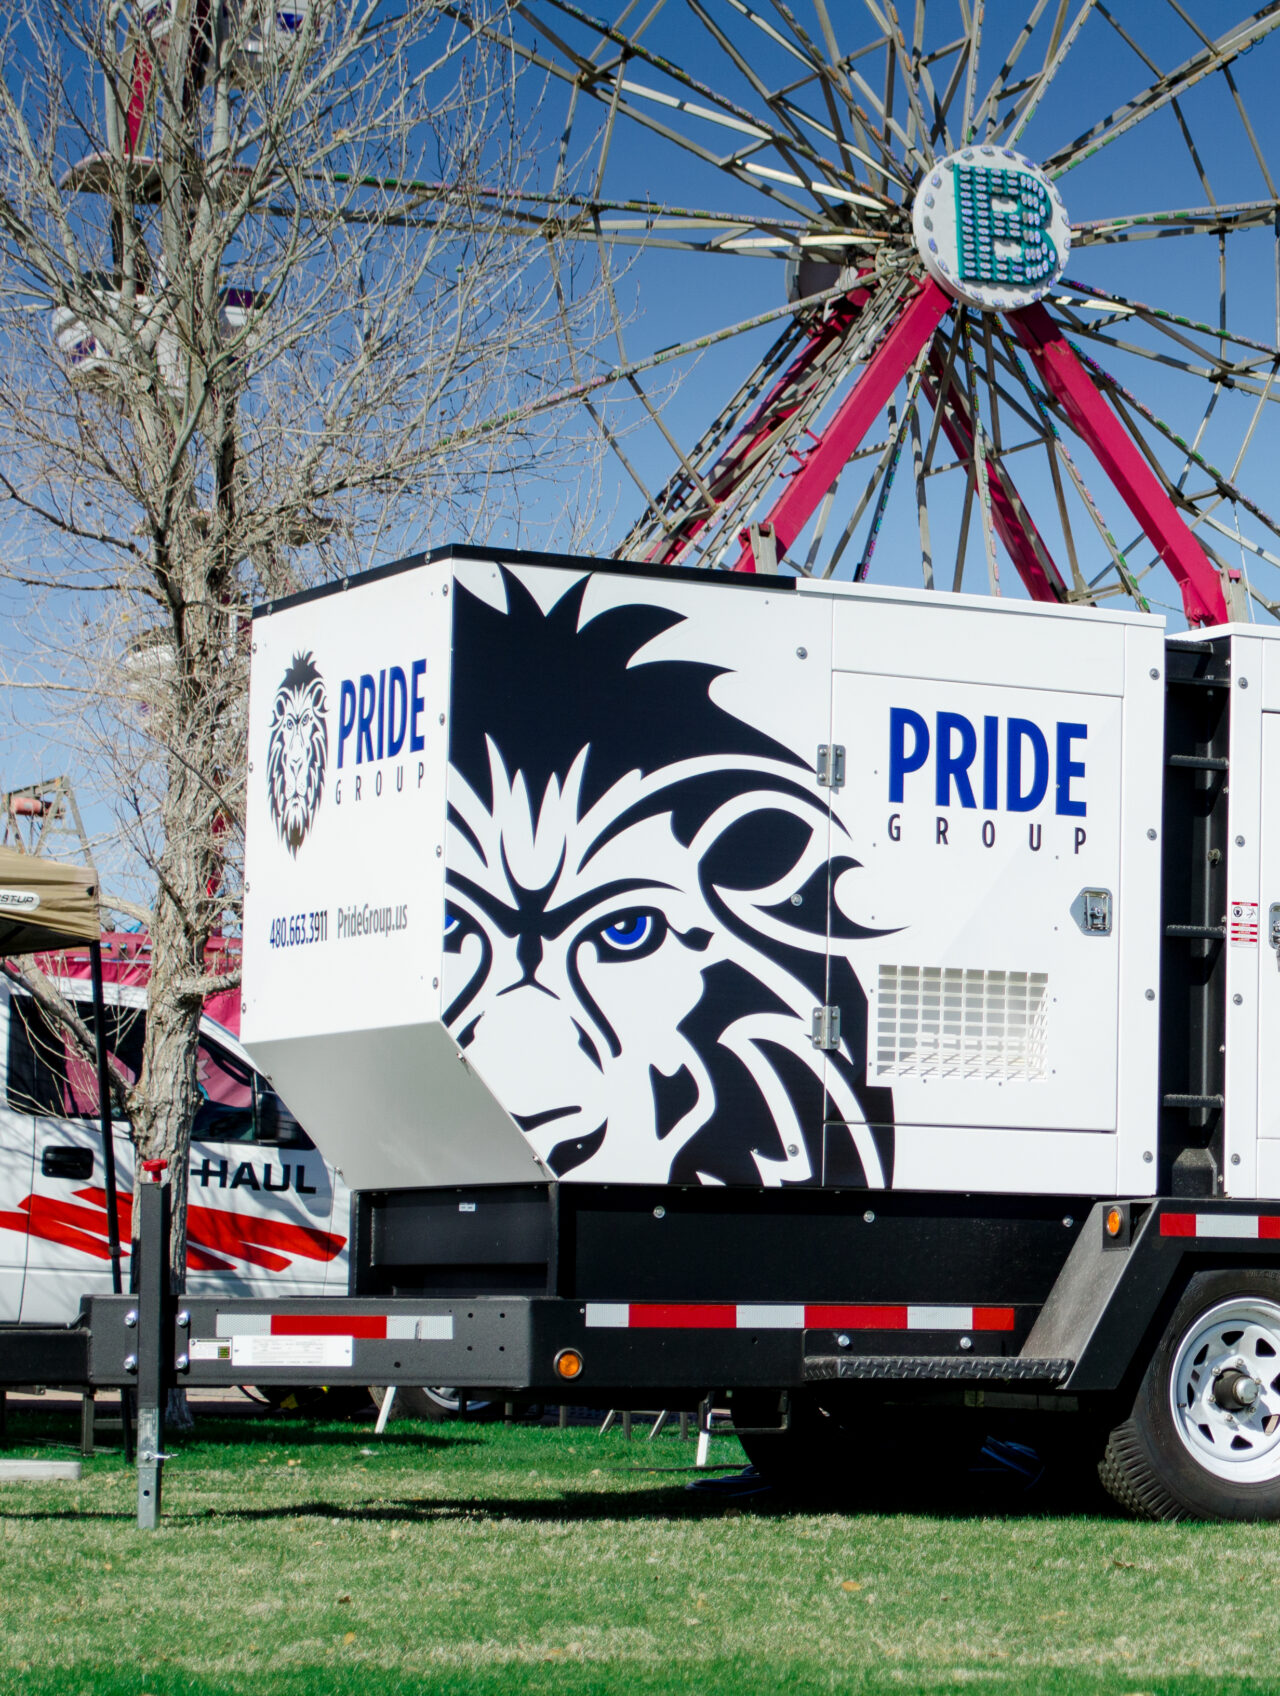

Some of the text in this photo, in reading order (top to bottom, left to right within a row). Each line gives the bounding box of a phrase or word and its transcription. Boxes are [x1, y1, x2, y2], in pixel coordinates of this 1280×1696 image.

[953, 164, 1058, 286] B
[337, 658, 427, 769] PRIDE
[335, 761, 425, 806] GROUP
[888, 706, 1088, 818] PRIDE
[887, 813, 1087, 855] GROUP
[269, 902, 408, 949] 480.663.3911 PrideGroup.us
[190, 1158, 317, 1195] -HAUL
